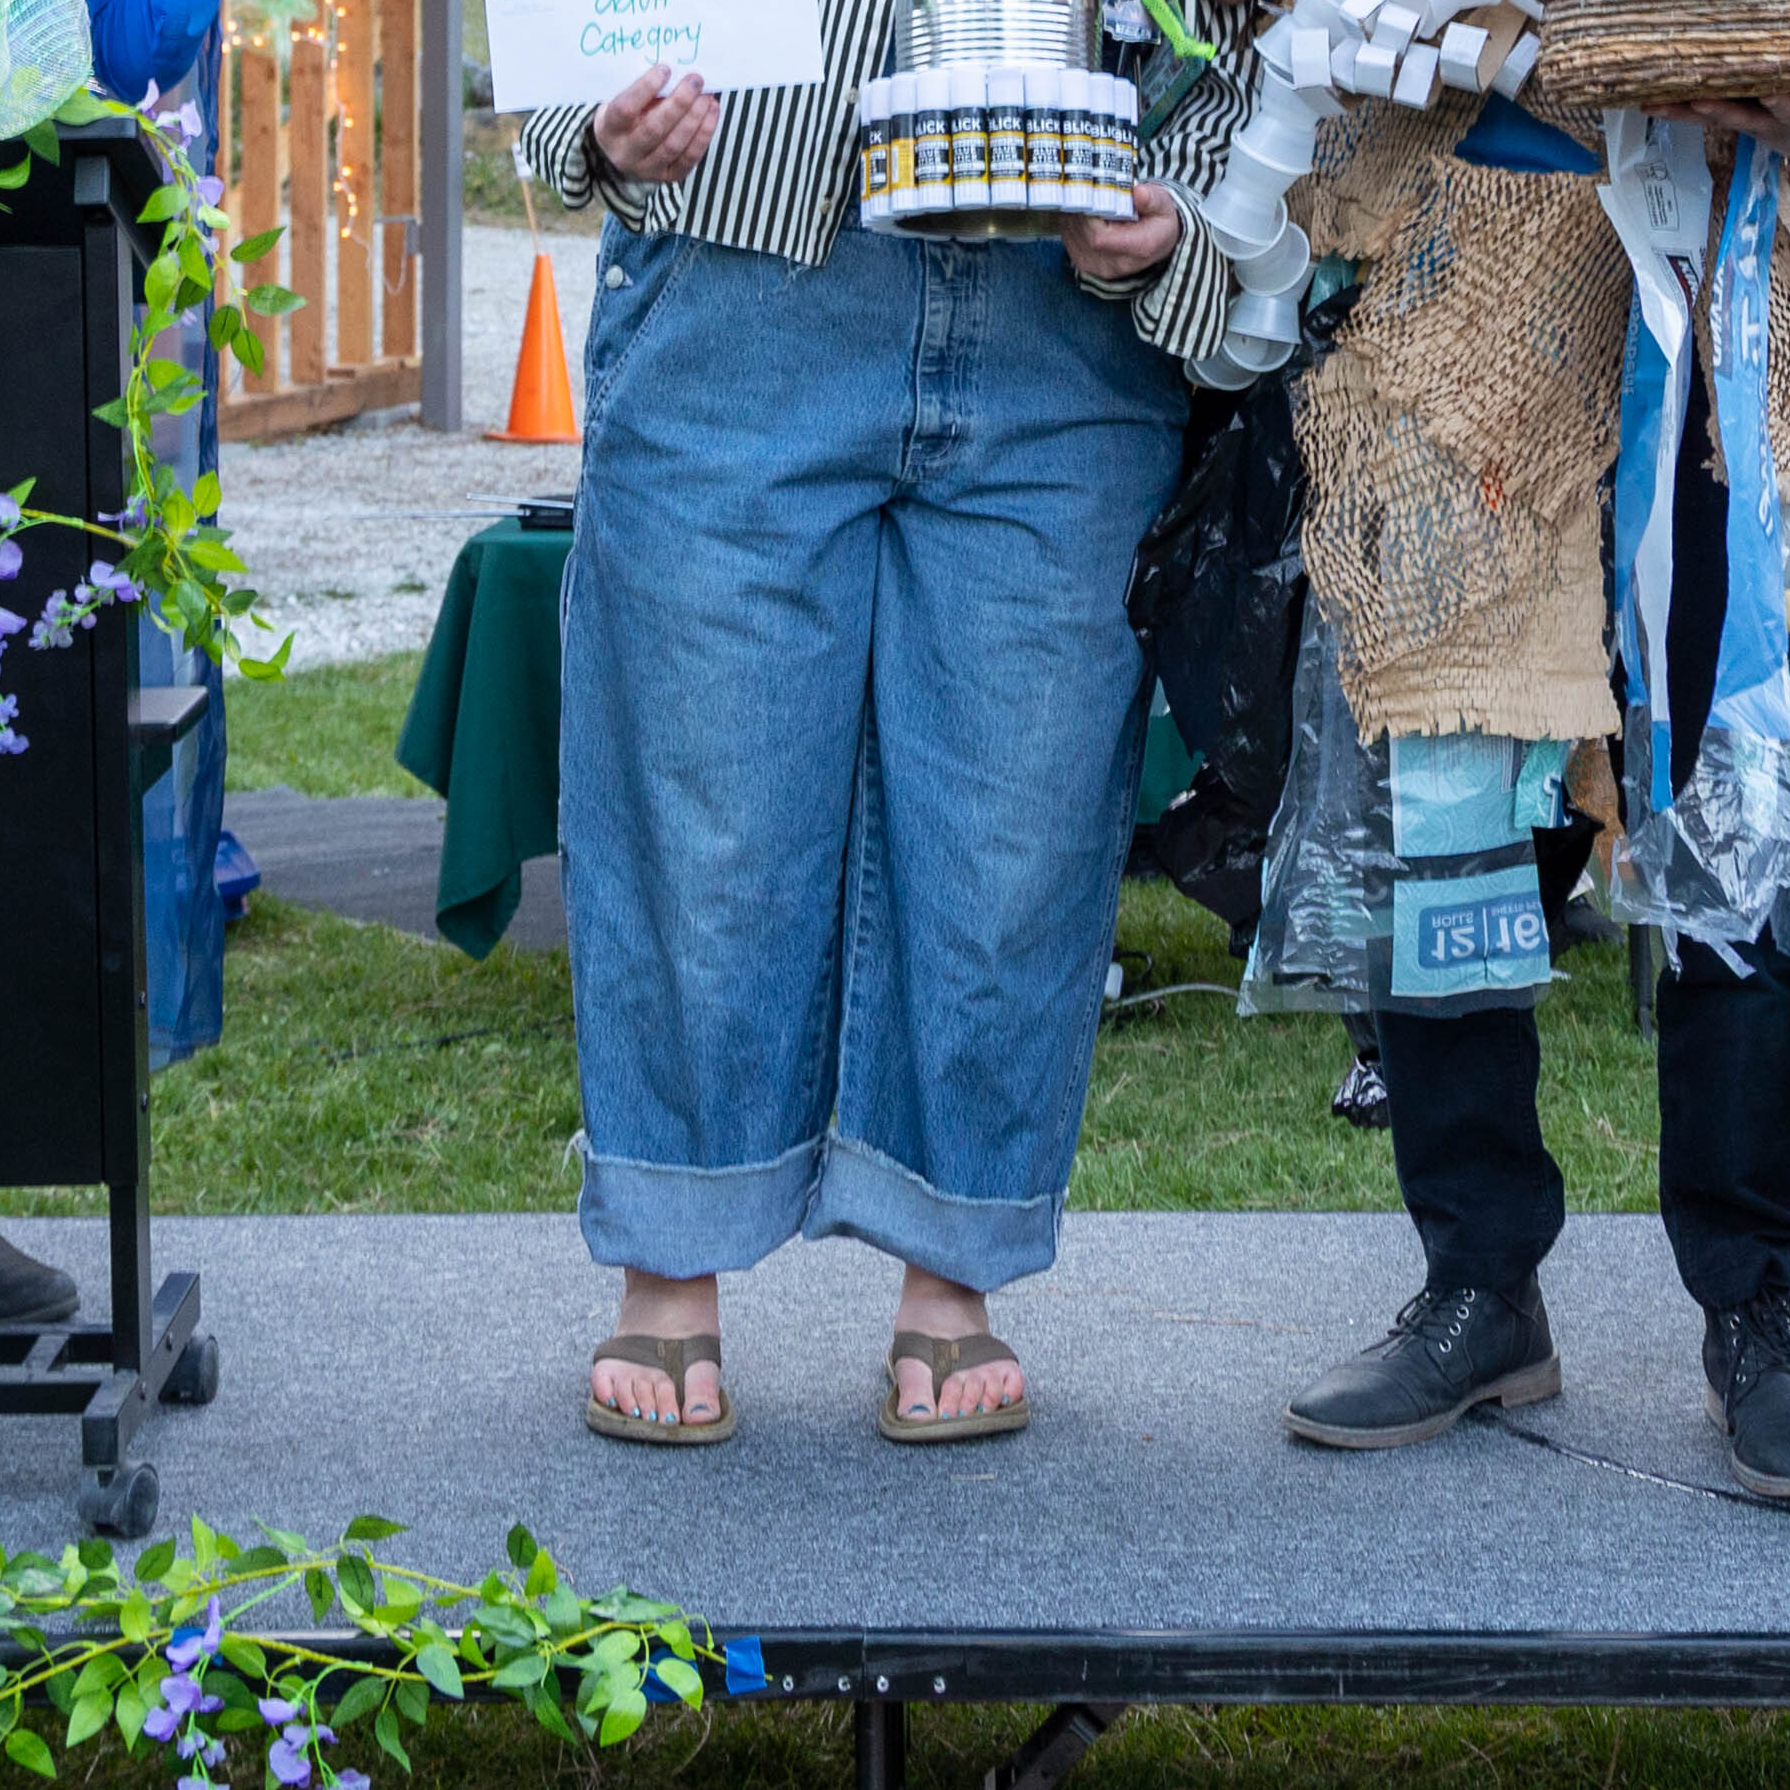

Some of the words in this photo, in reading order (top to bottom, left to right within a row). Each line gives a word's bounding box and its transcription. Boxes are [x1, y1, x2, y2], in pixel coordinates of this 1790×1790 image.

[580, 22, 702, 65] Category
[915, 119, 945, 136] LICK
[952, 117, 981, 133] LICK
[1063, 119, 1091, 134] BLIC
